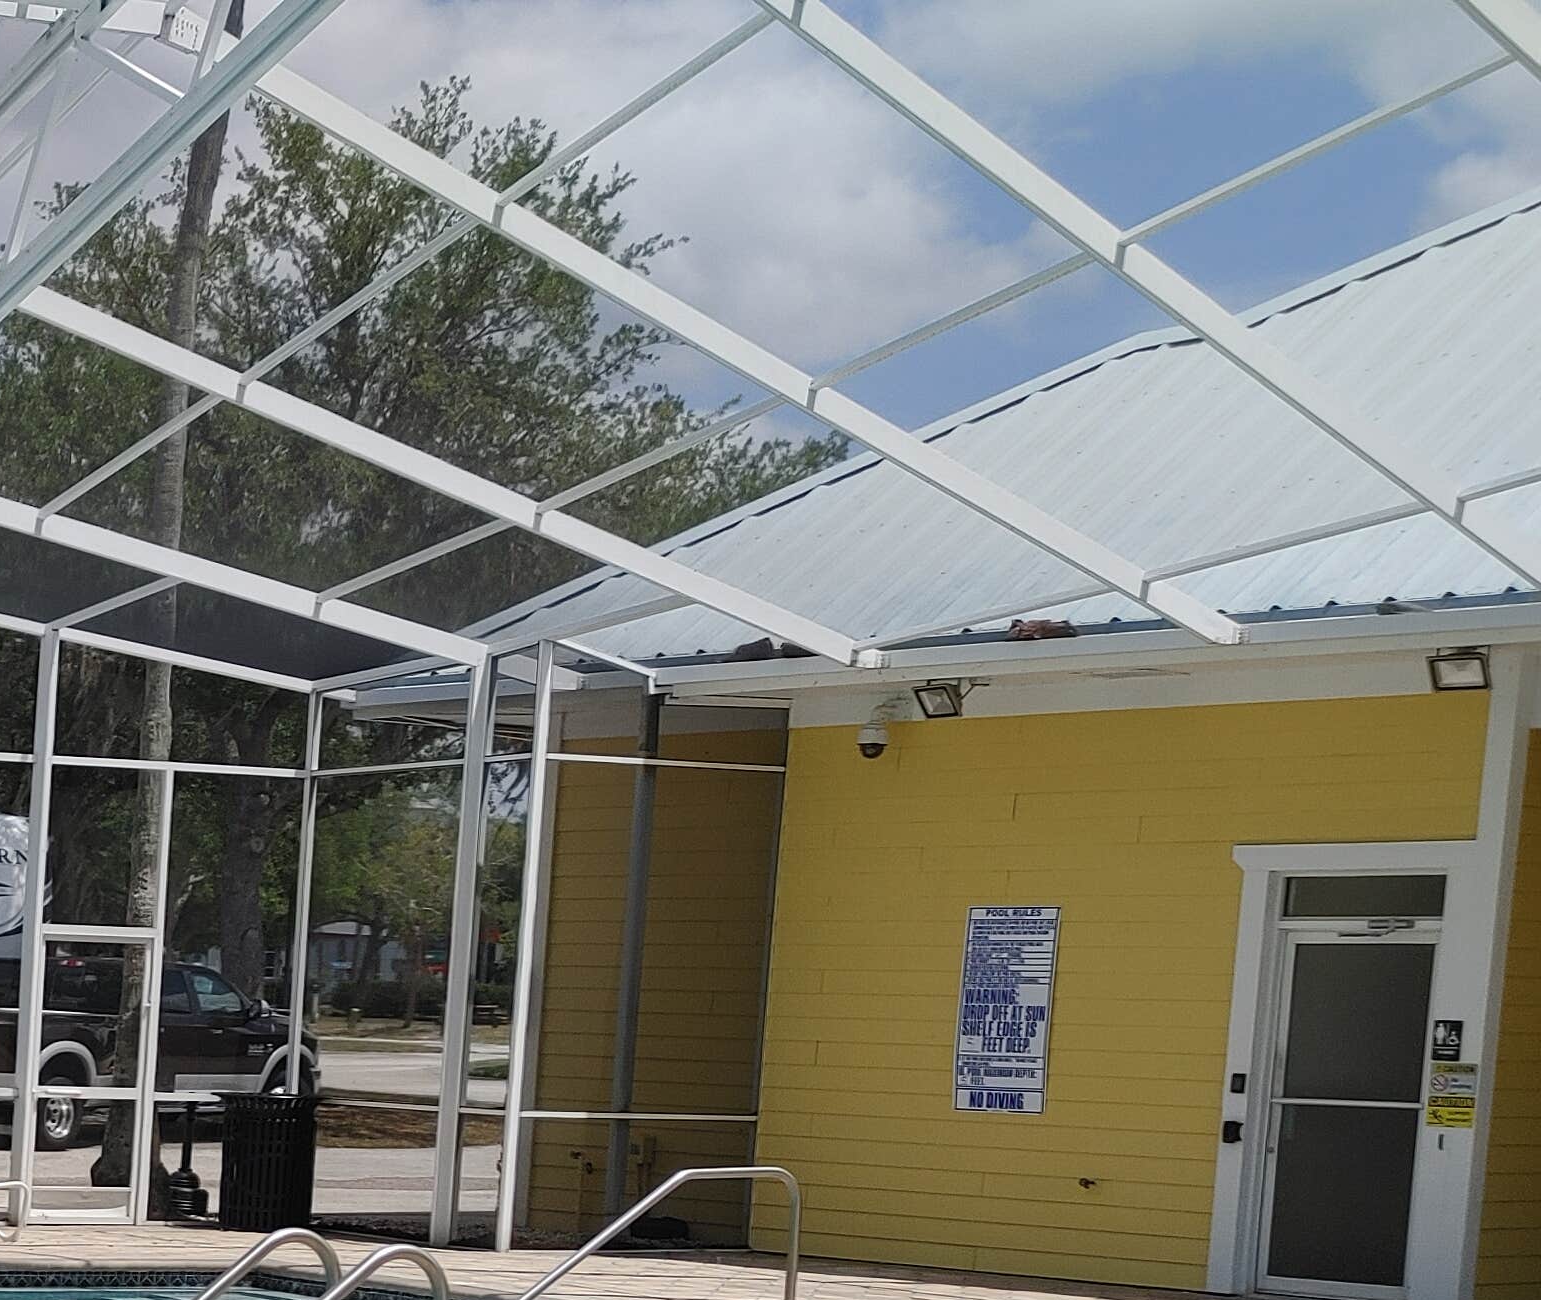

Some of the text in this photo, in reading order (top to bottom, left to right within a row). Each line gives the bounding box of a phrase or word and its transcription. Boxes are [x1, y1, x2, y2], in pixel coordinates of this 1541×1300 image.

[986, 909, 1042, 917] POOL RULES
[964, 988, 1020, 1005] WARNING:
[962, 1004, 1046, 1022] DROP OFF AT SUN
[961, 1020, 1038, 1038] SHELF EDGE IS
[981, 1036, 1005, 1053] FEET
[1006, 1037, 1032, 1054] DEEP.
[969, 1091, 1025, 1111] NO DIVING
